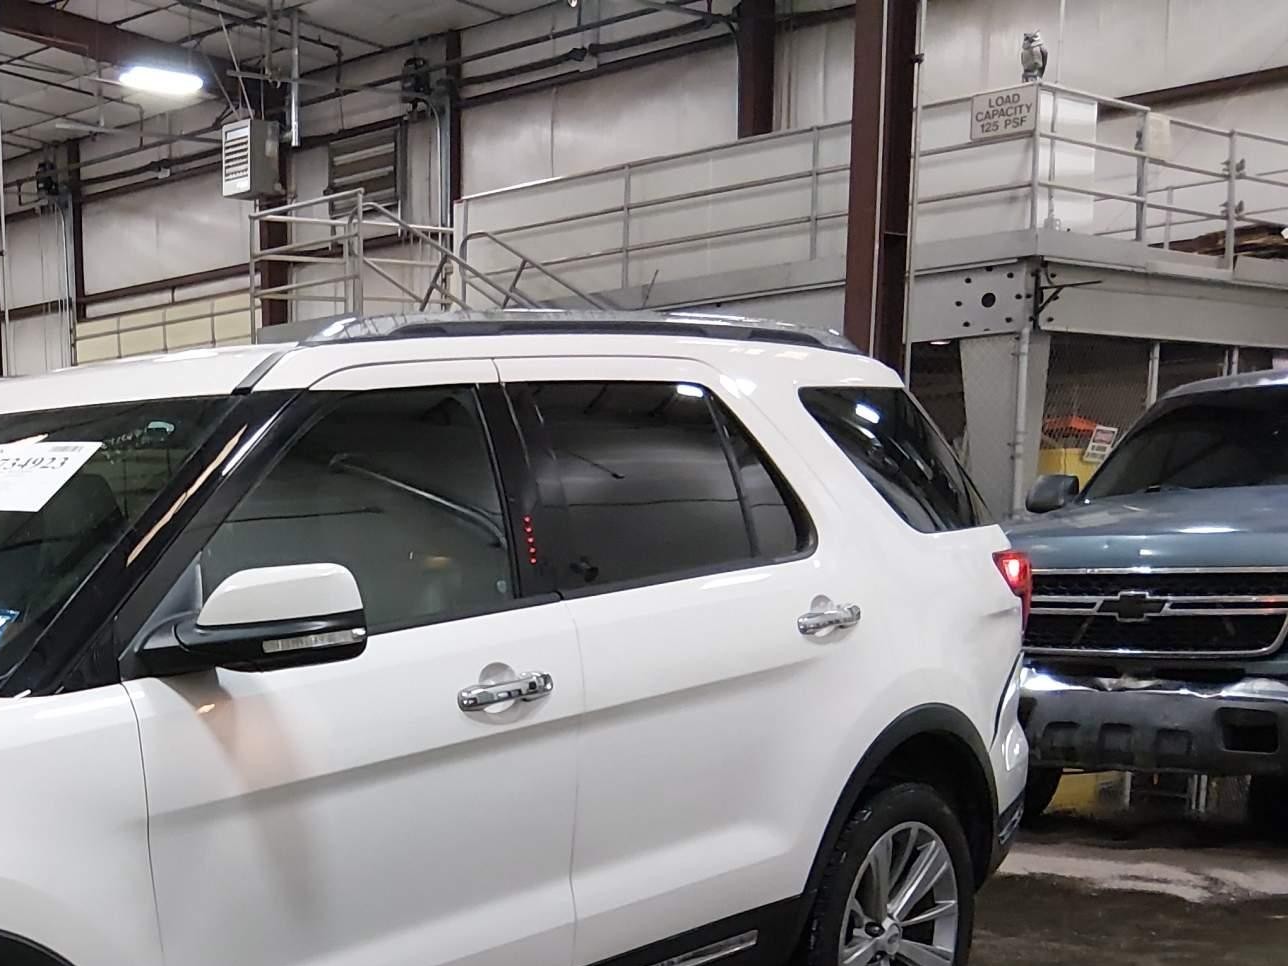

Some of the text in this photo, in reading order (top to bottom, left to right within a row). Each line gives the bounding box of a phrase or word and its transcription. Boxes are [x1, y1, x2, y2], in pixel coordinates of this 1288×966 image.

[988, 93, 1020, 109] LOAD
[975, 103, 1033, 122] CAPACITY
[980, 116, 1027, 133] 125 PSF
